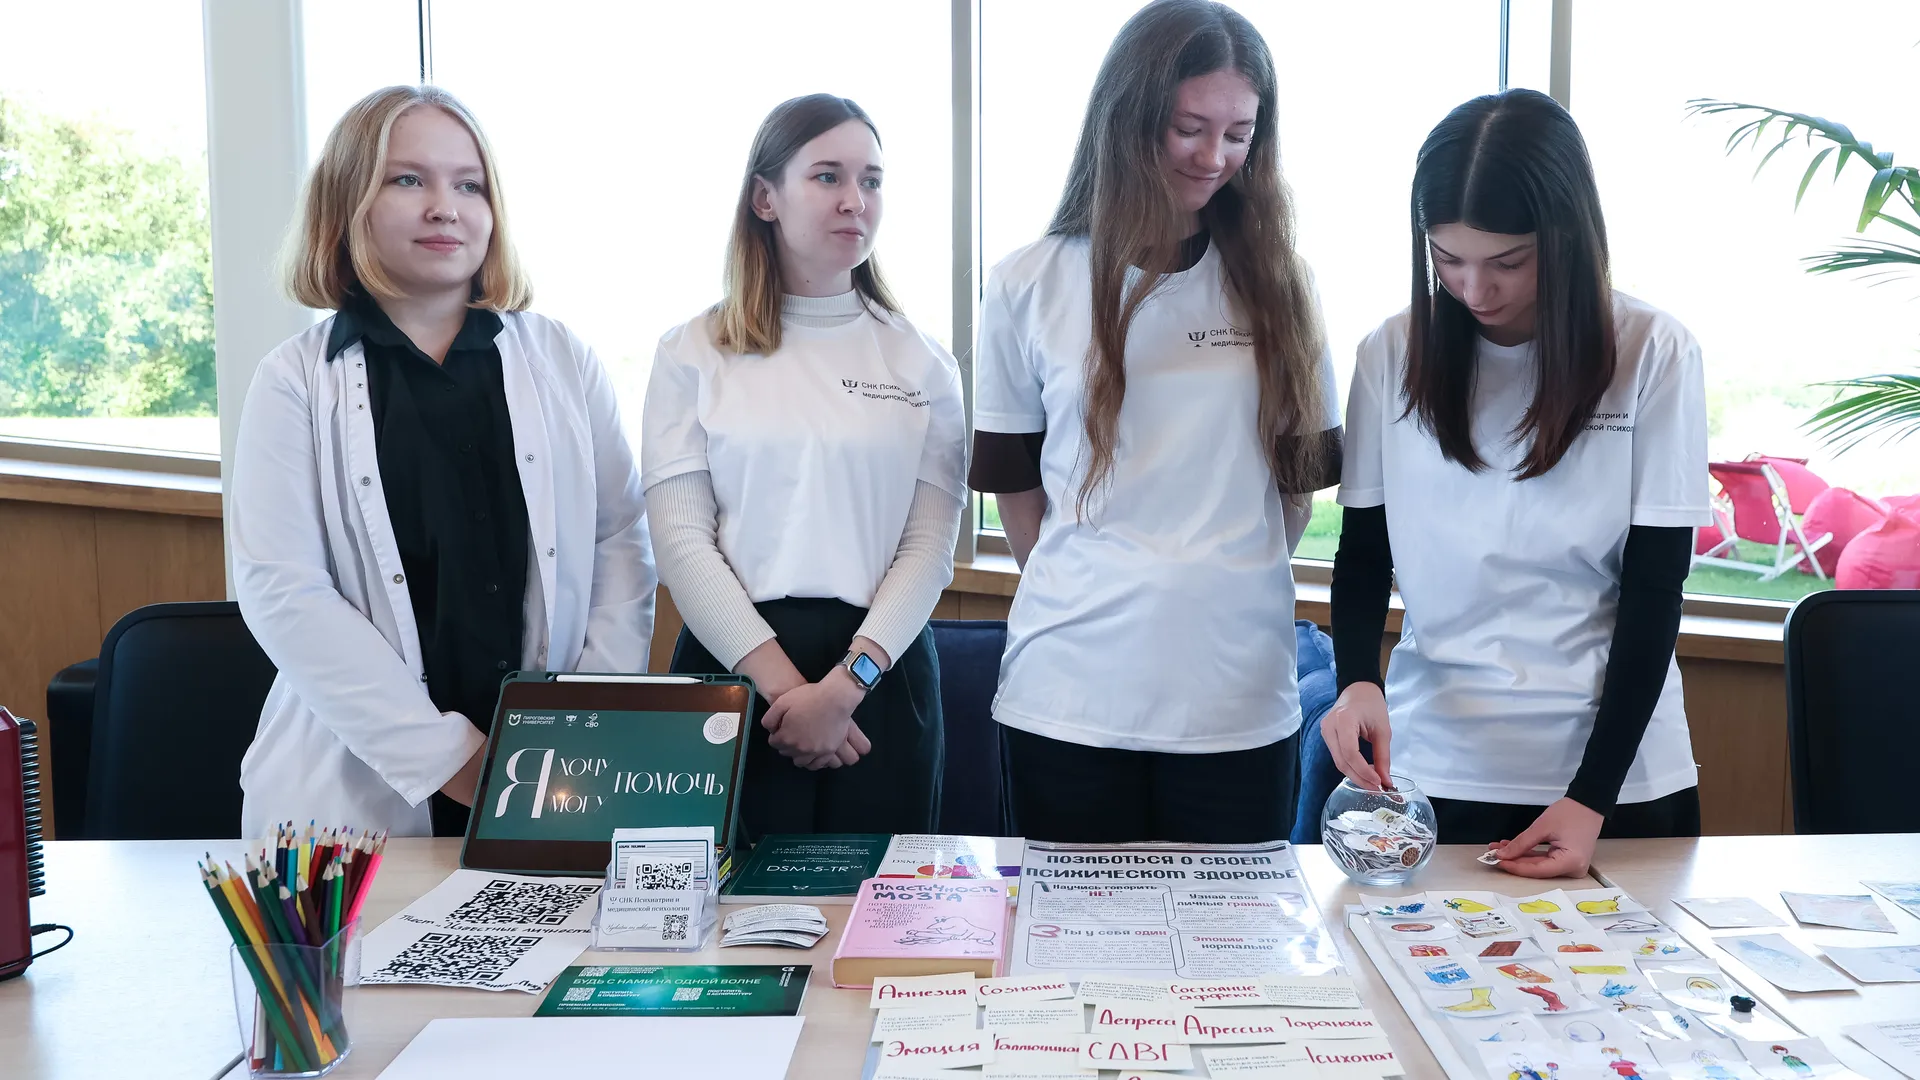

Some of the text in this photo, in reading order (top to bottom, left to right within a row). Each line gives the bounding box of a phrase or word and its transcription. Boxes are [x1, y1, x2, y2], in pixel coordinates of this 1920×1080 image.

[1209, 329, 1228, 337] СНК
[861, 382, 878, 390] СНК
[556, 757, 614, 777] ХОЧУ
[495, 748, 556, 819] Я
[613, 771, 725, 796] ПОМОЧЬ
[549, 795, 609, 814] МОГУ
[1046, 855, 1272, 866] ПОЗАБОТЬСЯ О СВОЕМ
[1026, 867, 1299, 881] ПСИХИЧЕСКОМ ЗДОРОВЬЕ
[871, 883, 999, 893] Пластичность
[634, 897, 675, 905] Психиатрии
[1189, 893, 1227, 901] Узнай
[1177, 900, 1224, 908] личные
[1029, 924, 1062, 939] 3
[1063, 927, 1082, 936] Ты
[1192, 935, 1245, 943] Эмоции
[1201, 942, 1274, 950] нормально
[674, 977, 719, 985] ОДНОЙ
[878, 984, 968, 1000] Амнезия
[979, 982, 1067, 997] Сознание
[1170, 984, 1257, 995] Состояние
[1178, 992, 1261, 1002] аффекта
[1183, 1014, 1275, 1039] Агрессия
[886, 1040, 981, 1057] Эмоция
